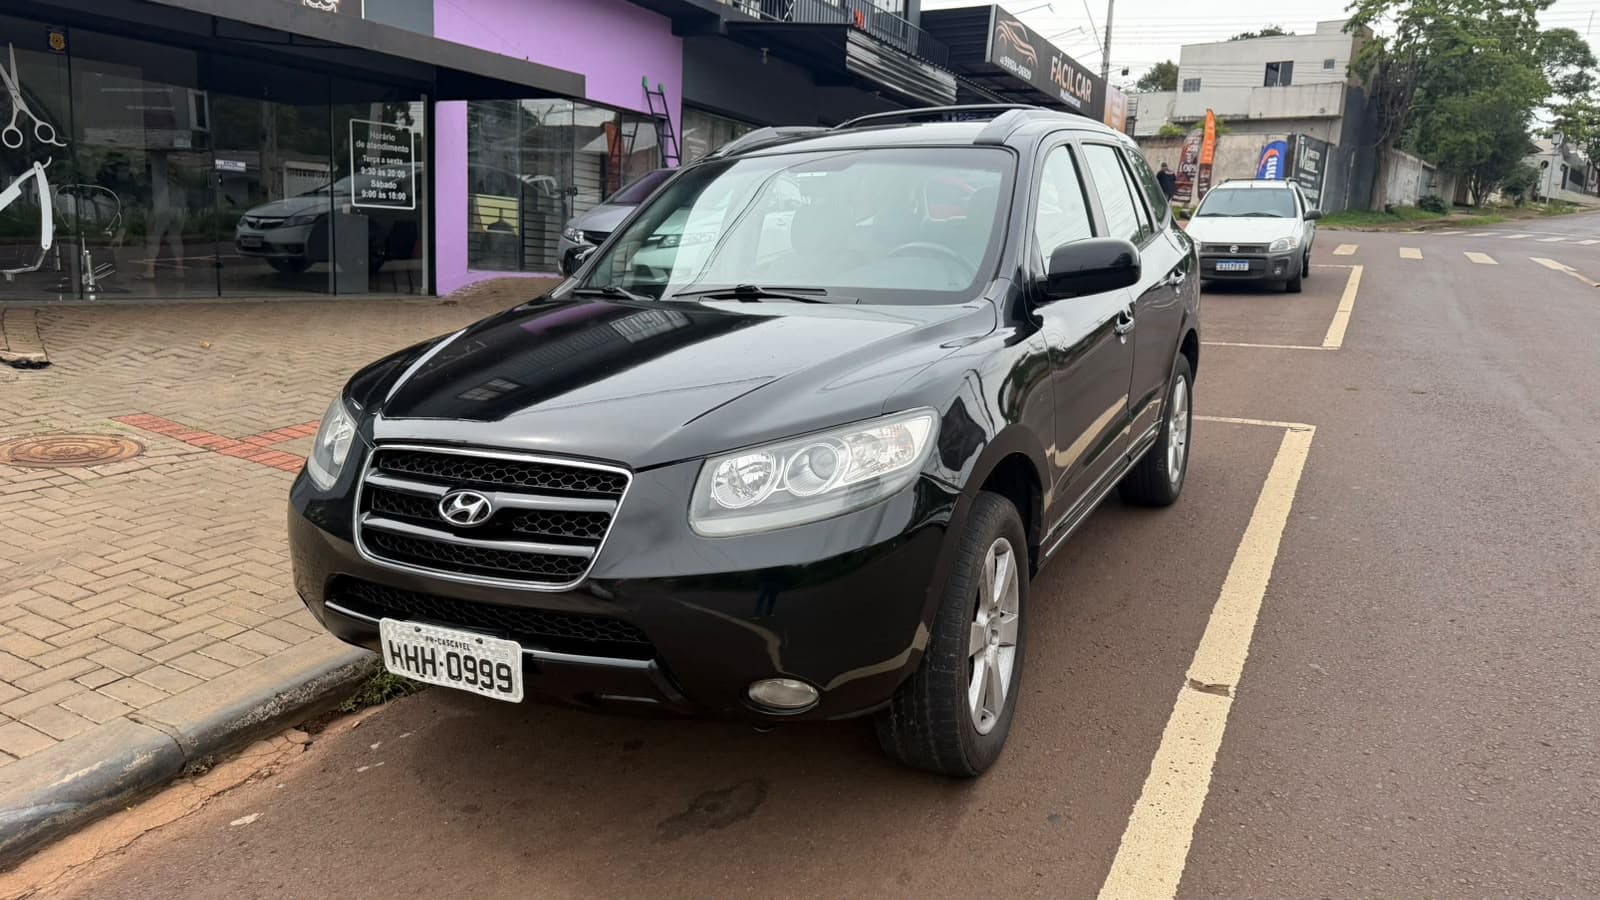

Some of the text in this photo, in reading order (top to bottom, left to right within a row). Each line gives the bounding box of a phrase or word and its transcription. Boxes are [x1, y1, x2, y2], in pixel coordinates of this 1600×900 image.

[1051, 52, 1075, 93] FÁCIL
[1075, 72, 1092, 104] CAR
[370, 130, 396, 142] Horário
[355, 139, 409, 153] de atendimento
[362, 155, 380, 164] Terça
[386, 157, 403, 165] sexta
[361, 166, 377, 175] 9:30
[387, 168, 406, 178] 20:00
[370, 179, 397, 189] Sábado
[361, 189, 377, 198] 9:00
[388, 191, 406, 200] 18:00
